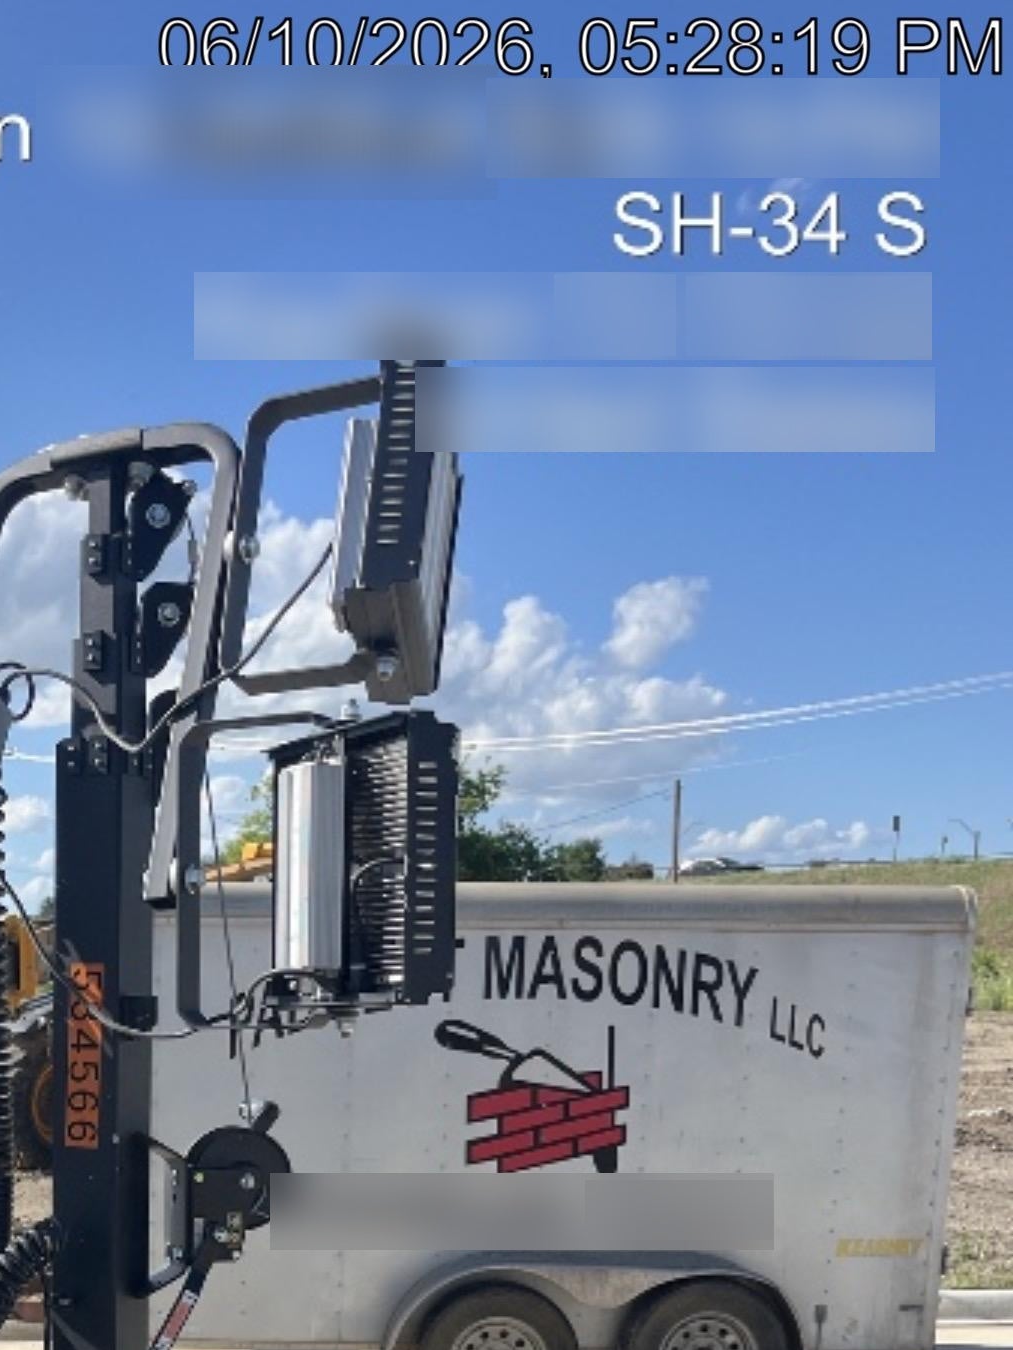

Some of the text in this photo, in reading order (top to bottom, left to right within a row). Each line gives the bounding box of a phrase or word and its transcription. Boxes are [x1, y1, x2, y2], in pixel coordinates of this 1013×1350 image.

[67, 970, 103, 1142] 534566
[483, 935, 826, 1059] MASONRY LLC
